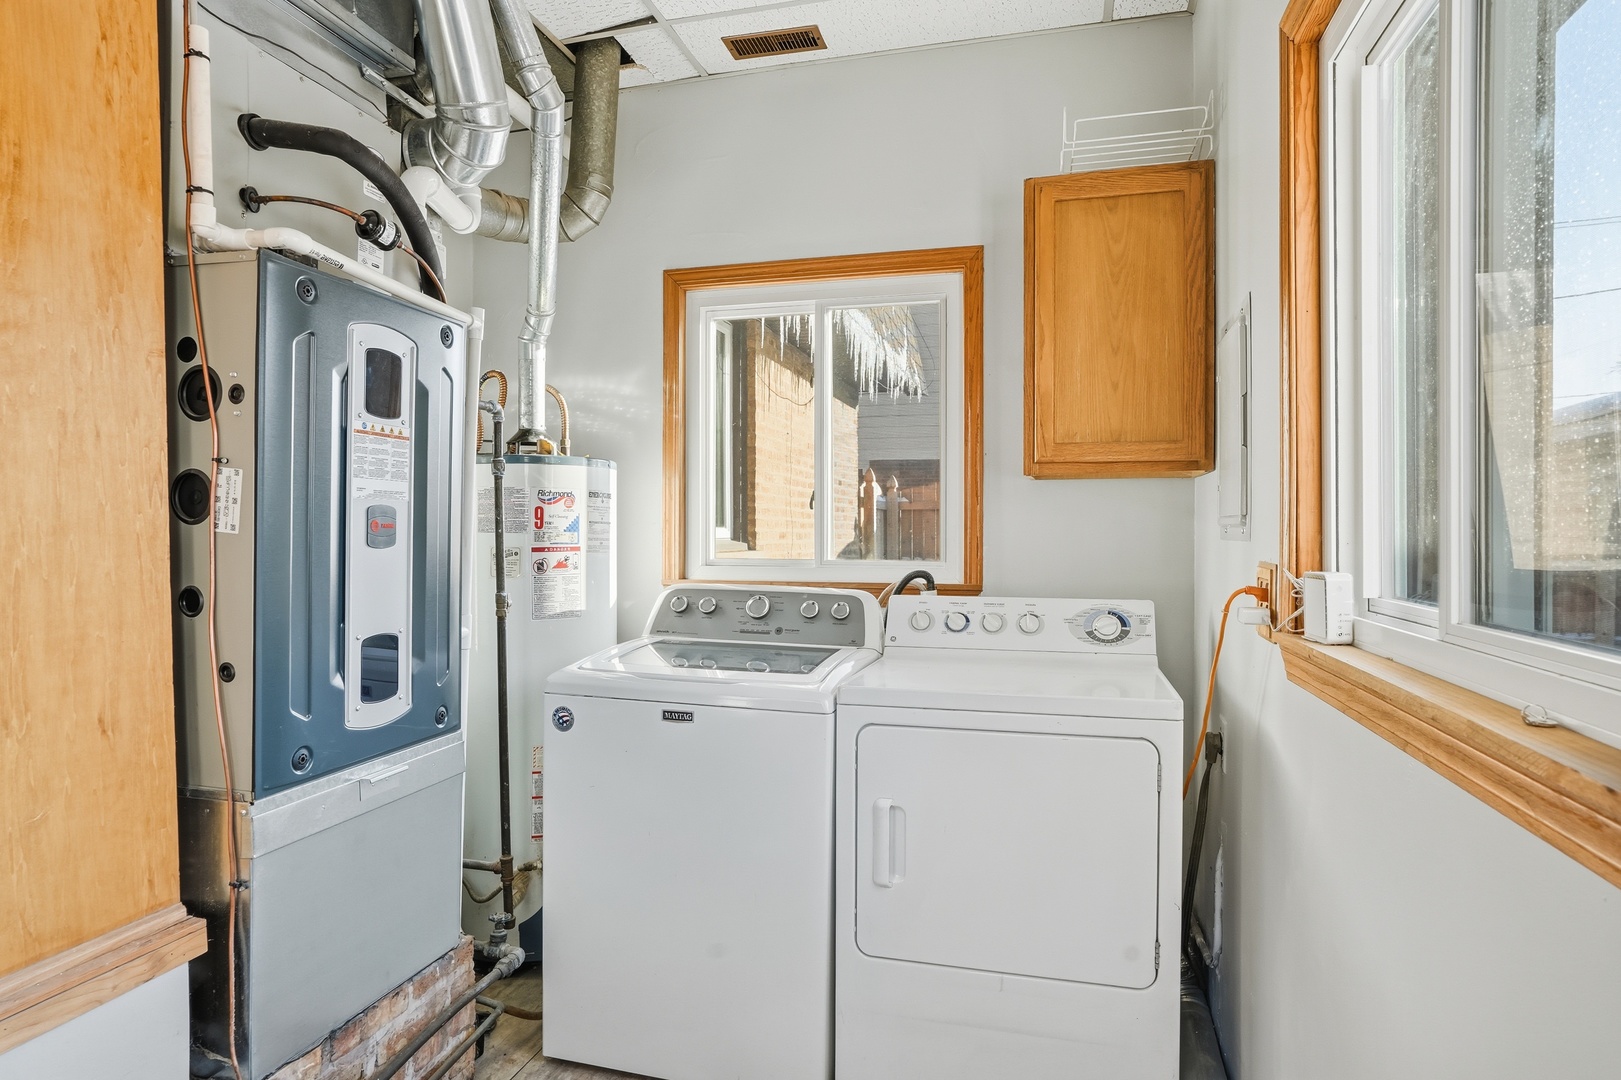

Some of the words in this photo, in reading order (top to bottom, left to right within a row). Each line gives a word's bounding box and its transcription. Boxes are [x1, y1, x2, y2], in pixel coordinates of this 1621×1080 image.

[537, 489, 573, 497] Richmond
[534, 506, 544, 529] 9
[664, 712, 692, 720] MAYTAG
